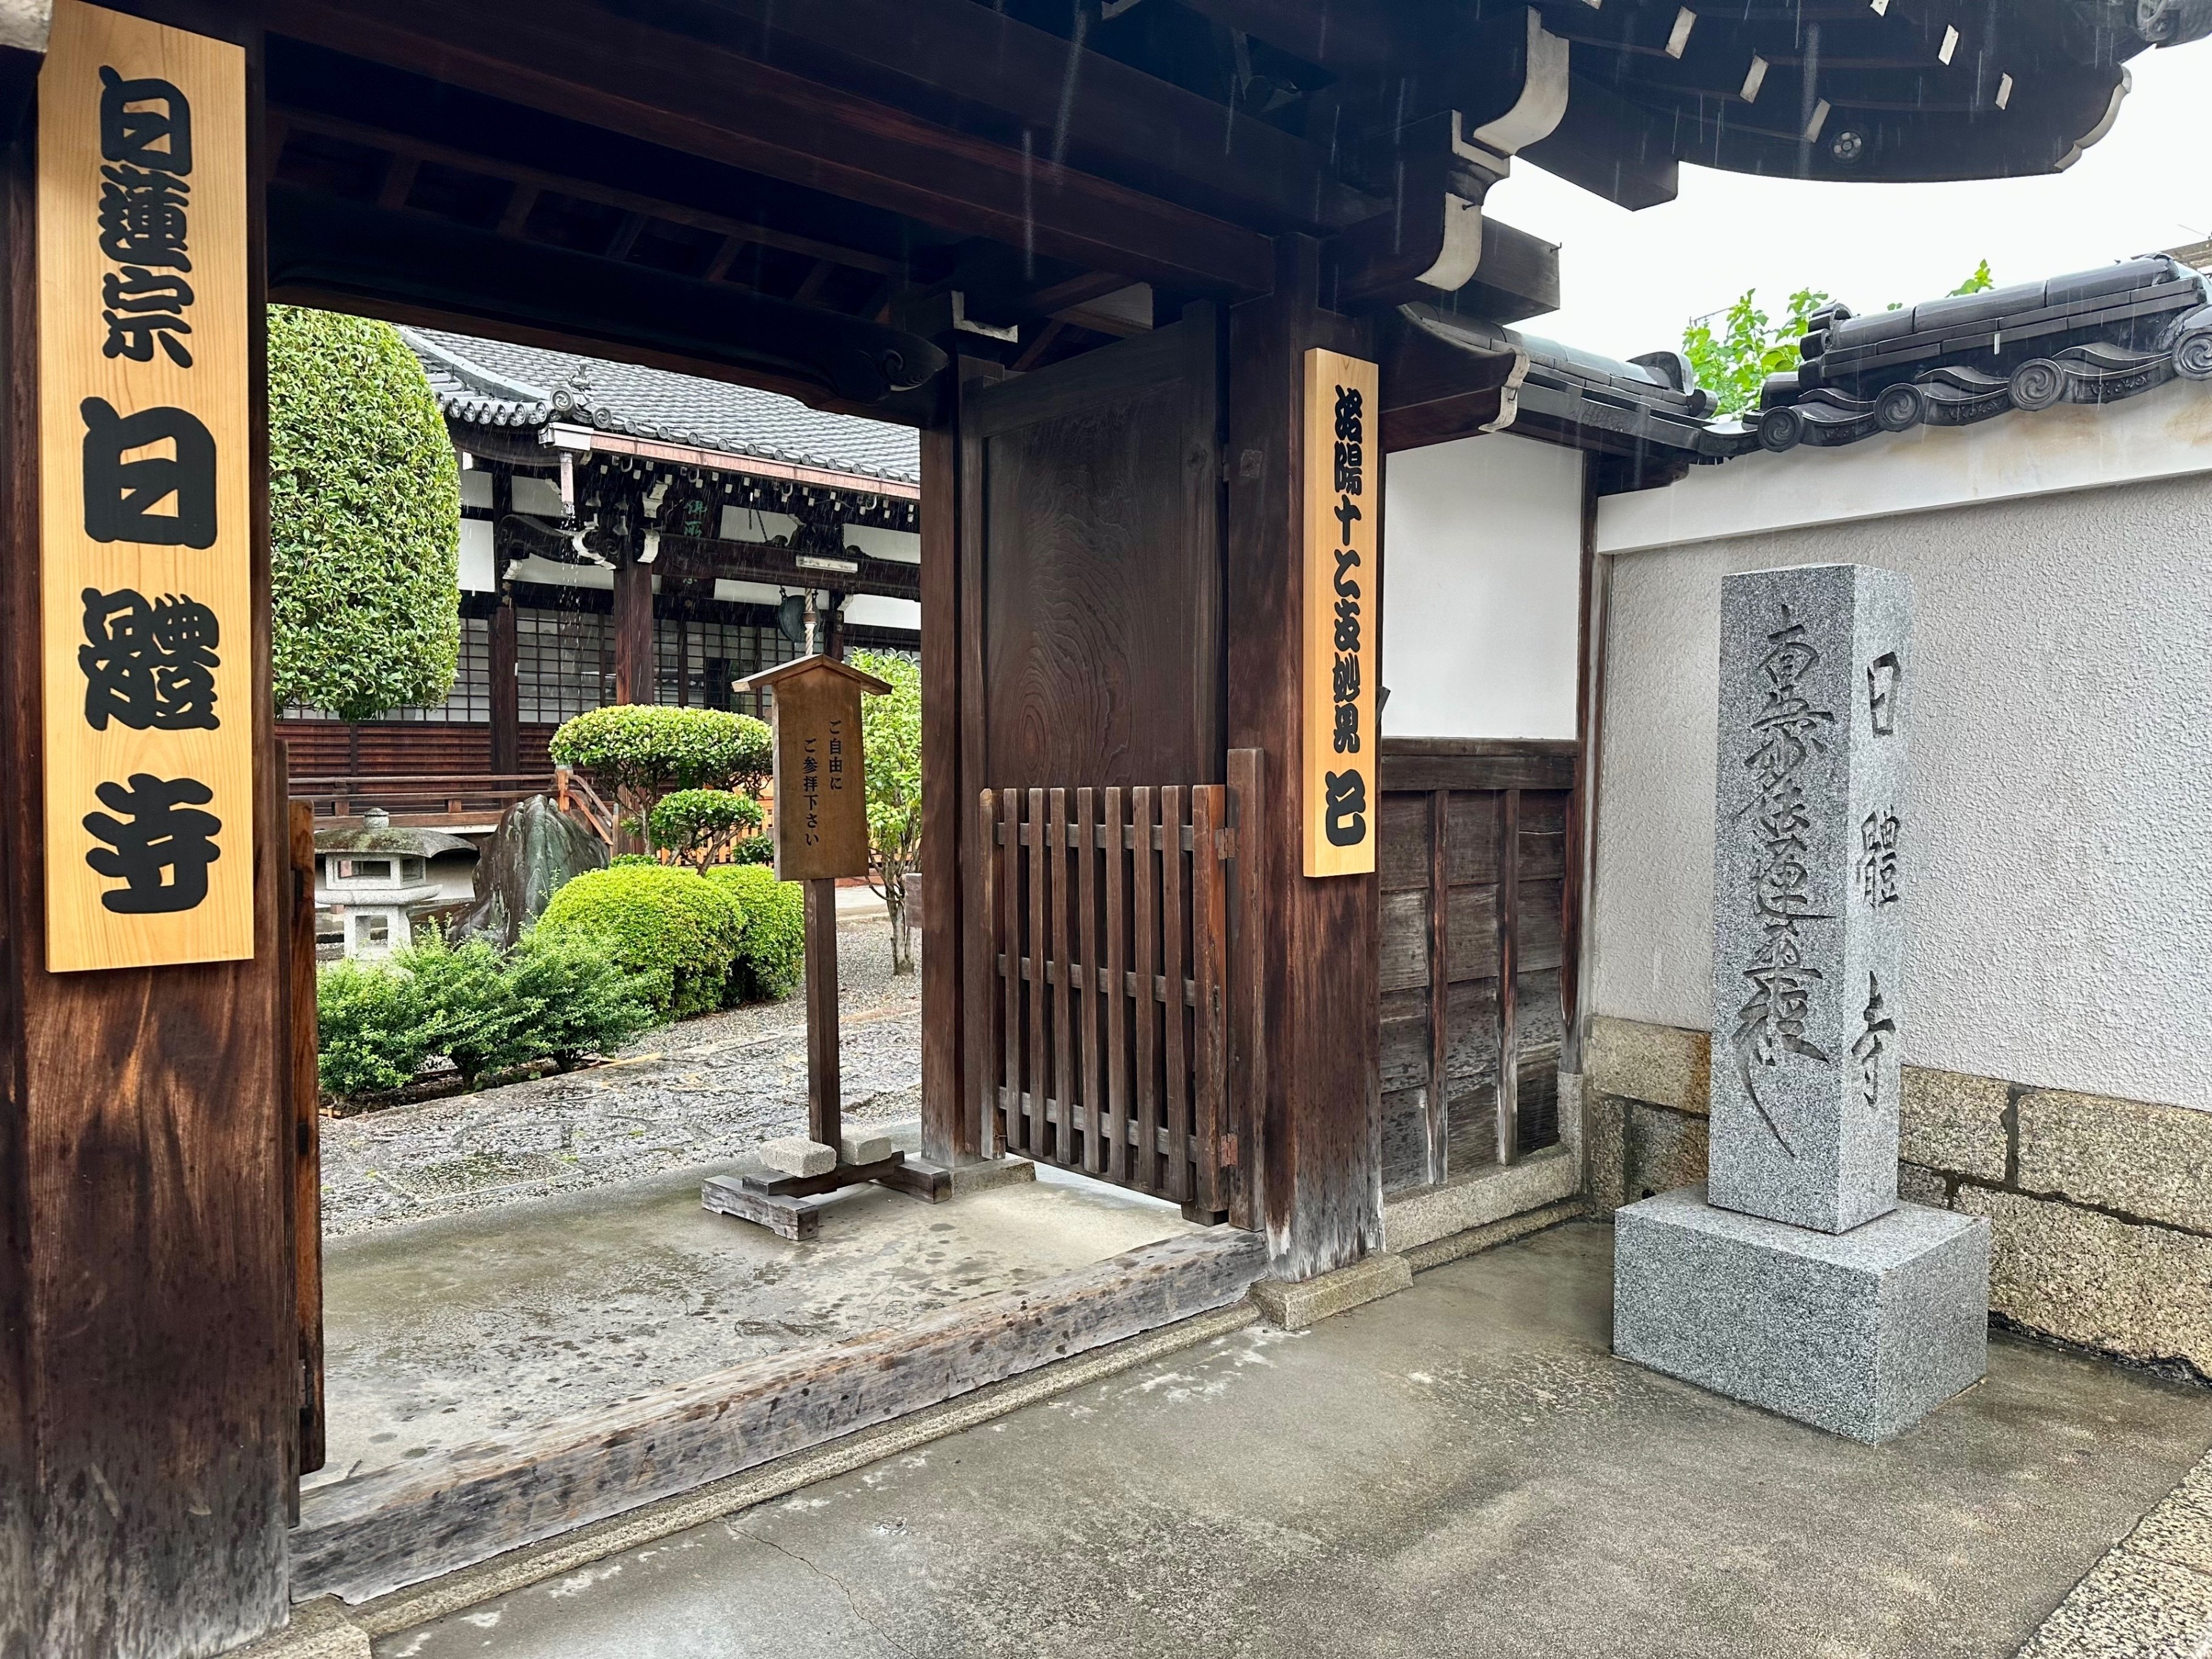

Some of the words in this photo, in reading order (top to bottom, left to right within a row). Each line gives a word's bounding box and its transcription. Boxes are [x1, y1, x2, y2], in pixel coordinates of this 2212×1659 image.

[98, 64, 194, 369] 日蓮宗
[802, 738, 820, 847] ご参拝下さい
[829, 719, 843, 791] ご自由に
